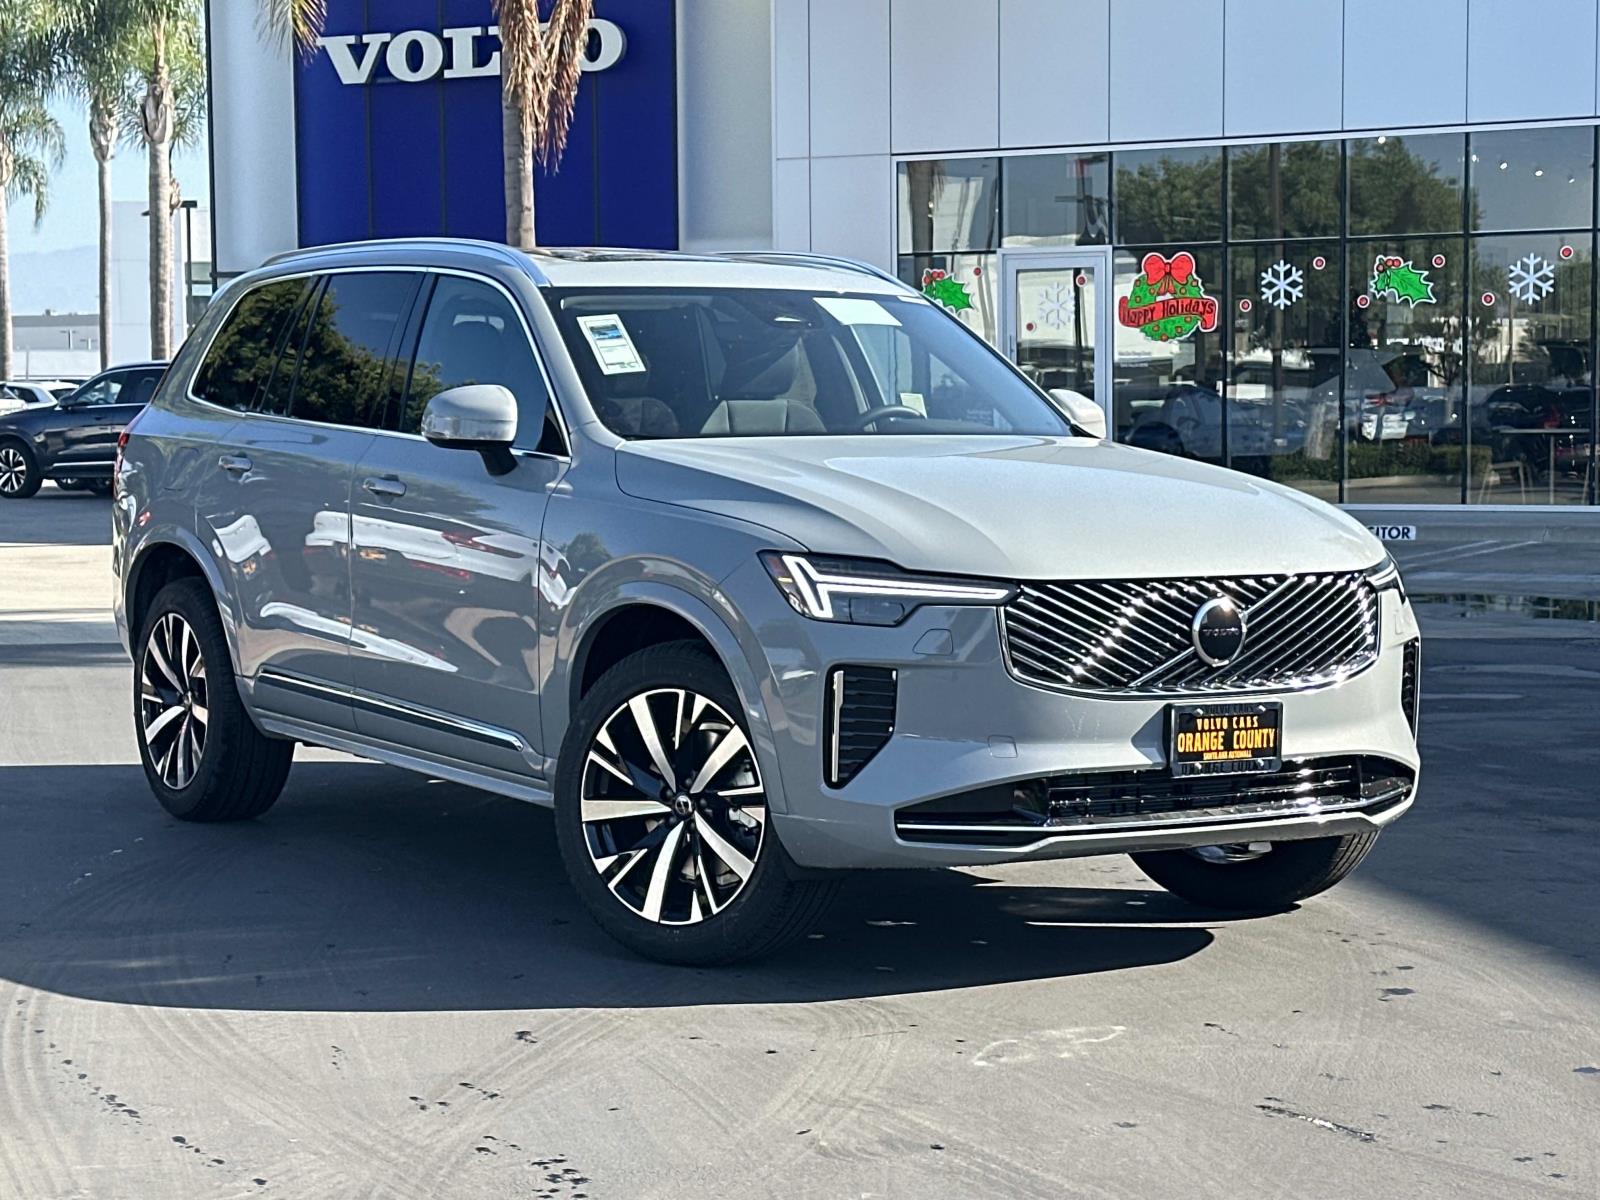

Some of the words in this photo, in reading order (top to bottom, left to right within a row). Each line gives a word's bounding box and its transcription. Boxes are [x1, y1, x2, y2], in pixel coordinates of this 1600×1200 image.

[316, 18, 626, 85] VOLO
[1162, 300, 1214, 317] Holidays
[1368, 526, 1411, 540] ITOR
[1197, 718, 1228, 730] VOLVO
[1233, 716, 1258, 729] CARS
[1178, 731, 1225, 752] ORANGE
[1233, 728, 1275, 749] COUNTY
